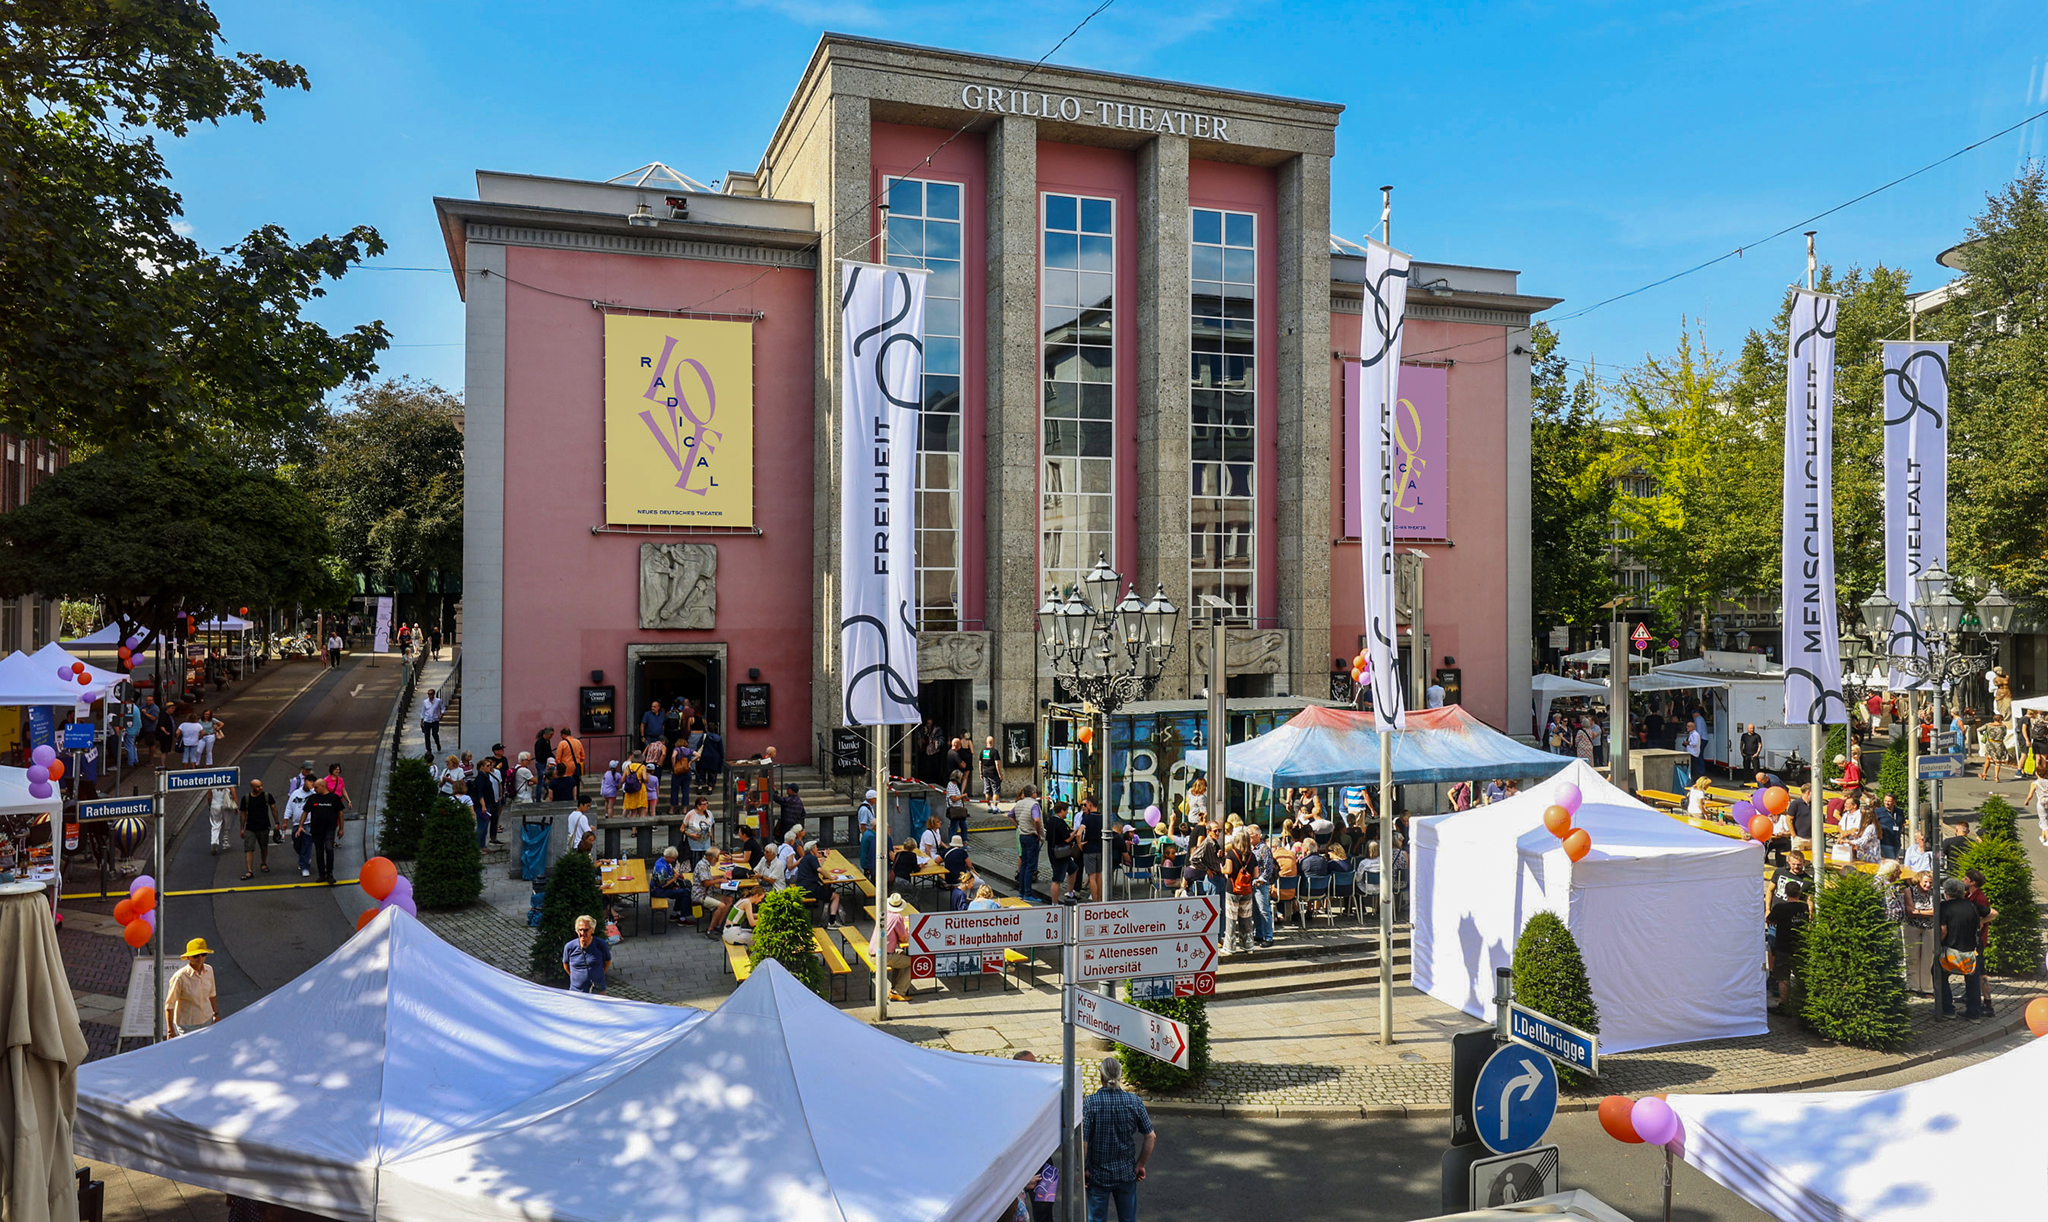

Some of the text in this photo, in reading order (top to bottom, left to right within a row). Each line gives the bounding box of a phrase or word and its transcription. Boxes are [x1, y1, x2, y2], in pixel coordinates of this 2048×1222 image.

[962, 84, 1230, 141] GRILLO-THEATER
[640, 356, 719, 487] RADICAL
[874, 416, 890, 575] FREIHEIT
[1907, 458, 1922, 577] VIELFALT
[171, 774, 231, 787] Theaterplatz
[86, 804, 150, 817] Rathenaustr.
[945, 912, 1059, 929] Rüttenscheid 2.8
[1084, 904, 1190, 921] Borbeck 6.4
[1113, 919, 1190, 935] Zollverein 5.4
[960, 928, 1058, 947] Hauptbahnhof 0.3
[1099, 942, 1188, 959] Altenessen 4.0
[916, 962, 929, 971] 58
[1083, 958, 1188, 976] Universität 1.3
[1200, 979, 1211, 988] 57
[1077, 994, 1097, 1012] Kray
[1077, 1010, 1121, 1036] Frillendorf
[1150, 1020, 1160, 1034] 5.9
[1150, 1038, 1160, 1051] 3.0
[1514, 1014, 1585, 1062] I.Dellbrügge
